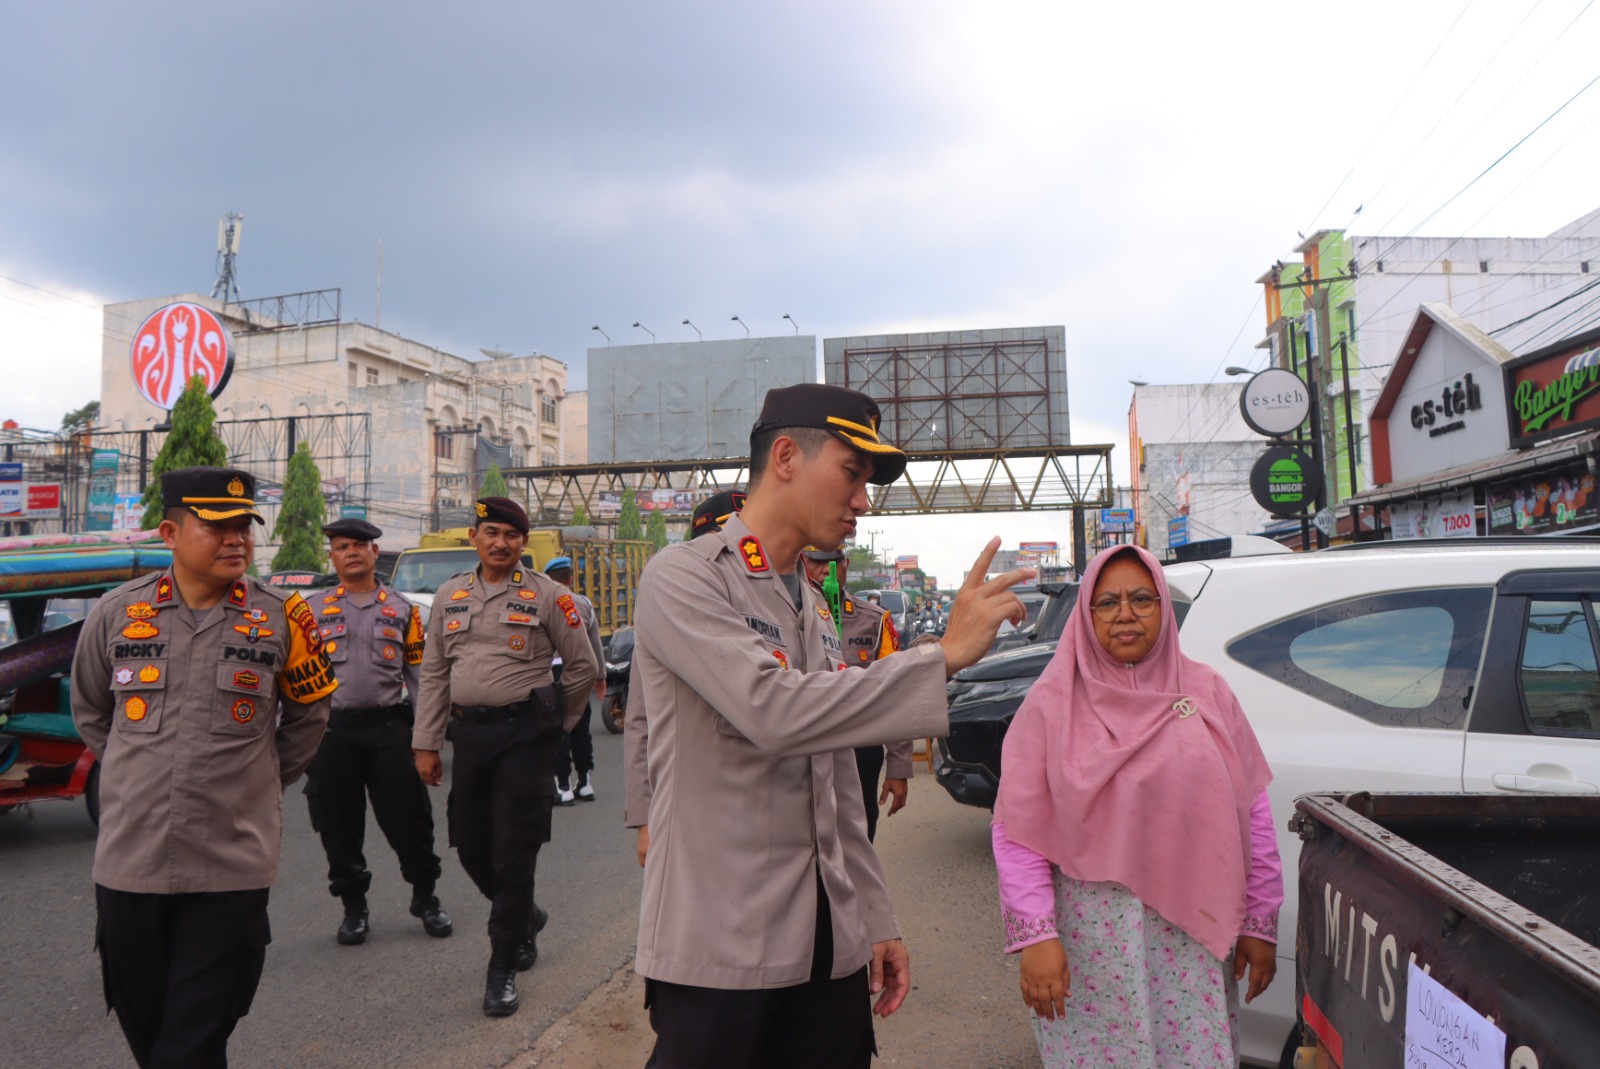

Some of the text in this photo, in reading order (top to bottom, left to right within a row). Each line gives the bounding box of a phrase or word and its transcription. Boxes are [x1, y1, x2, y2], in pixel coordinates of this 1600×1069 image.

[0, 489, 19, 497] ATM
[1269, 483, 1303, 493] BANGOR
[1442, 513, 1471, 531] 7.000
[506, 602, 538, 615] POLRI
[848, 637, 873, 646] POLRI
[114, 642, 165, 659] RICKY
[223, 646, 277, 666] POLRI
[284, 659, 320, 685] WAKA
[1418, 981, 1480, 1052] LOWONGAN
[1436, 1031, 1468, 1068] KERJA
